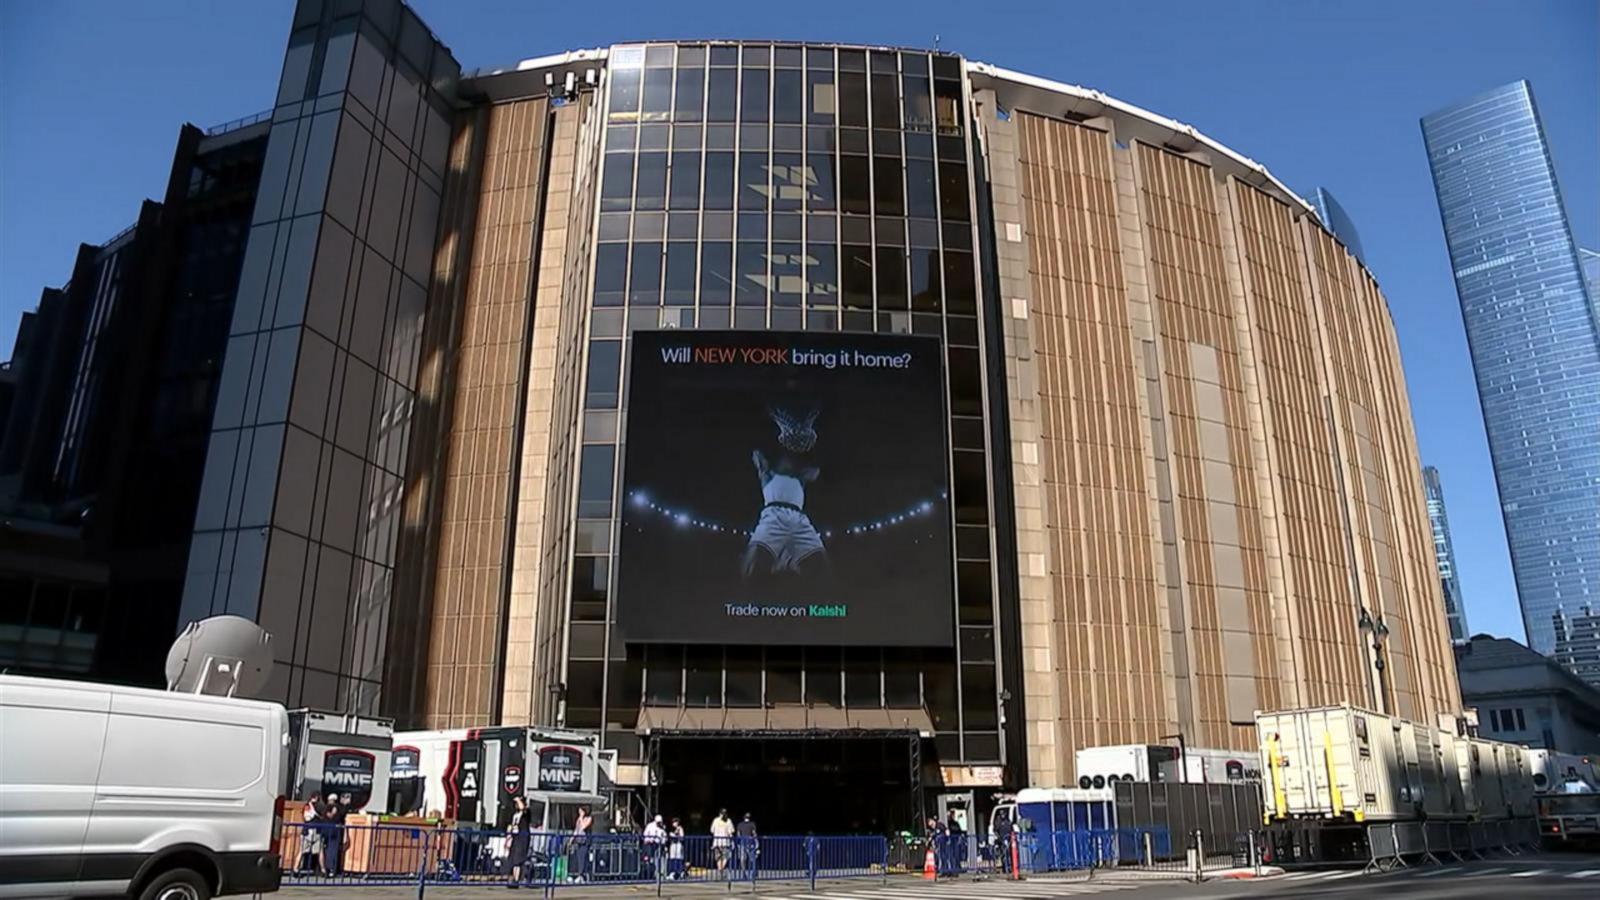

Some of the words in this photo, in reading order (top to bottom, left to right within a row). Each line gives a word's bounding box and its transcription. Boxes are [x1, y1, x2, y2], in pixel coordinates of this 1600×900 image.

[661, 348, 691, 363] Will
[694, 349, 736, 363] NEW
[740, 349, 788, 364] YORK
[792, 348, 836, 369] bring
[840, 350, 850, 366] it
[854, 350, 912, 368] home?
[725, 603, 759, 616] Trade
[761, 606, 788, 616] now
[790, 606, 806, 616] on
[809, 604, 847, 617] Kalshi
[324, 771, 372, 786] MNF
[463, 772, 477, 788] A
[540, 769, 581, 783] MNF
